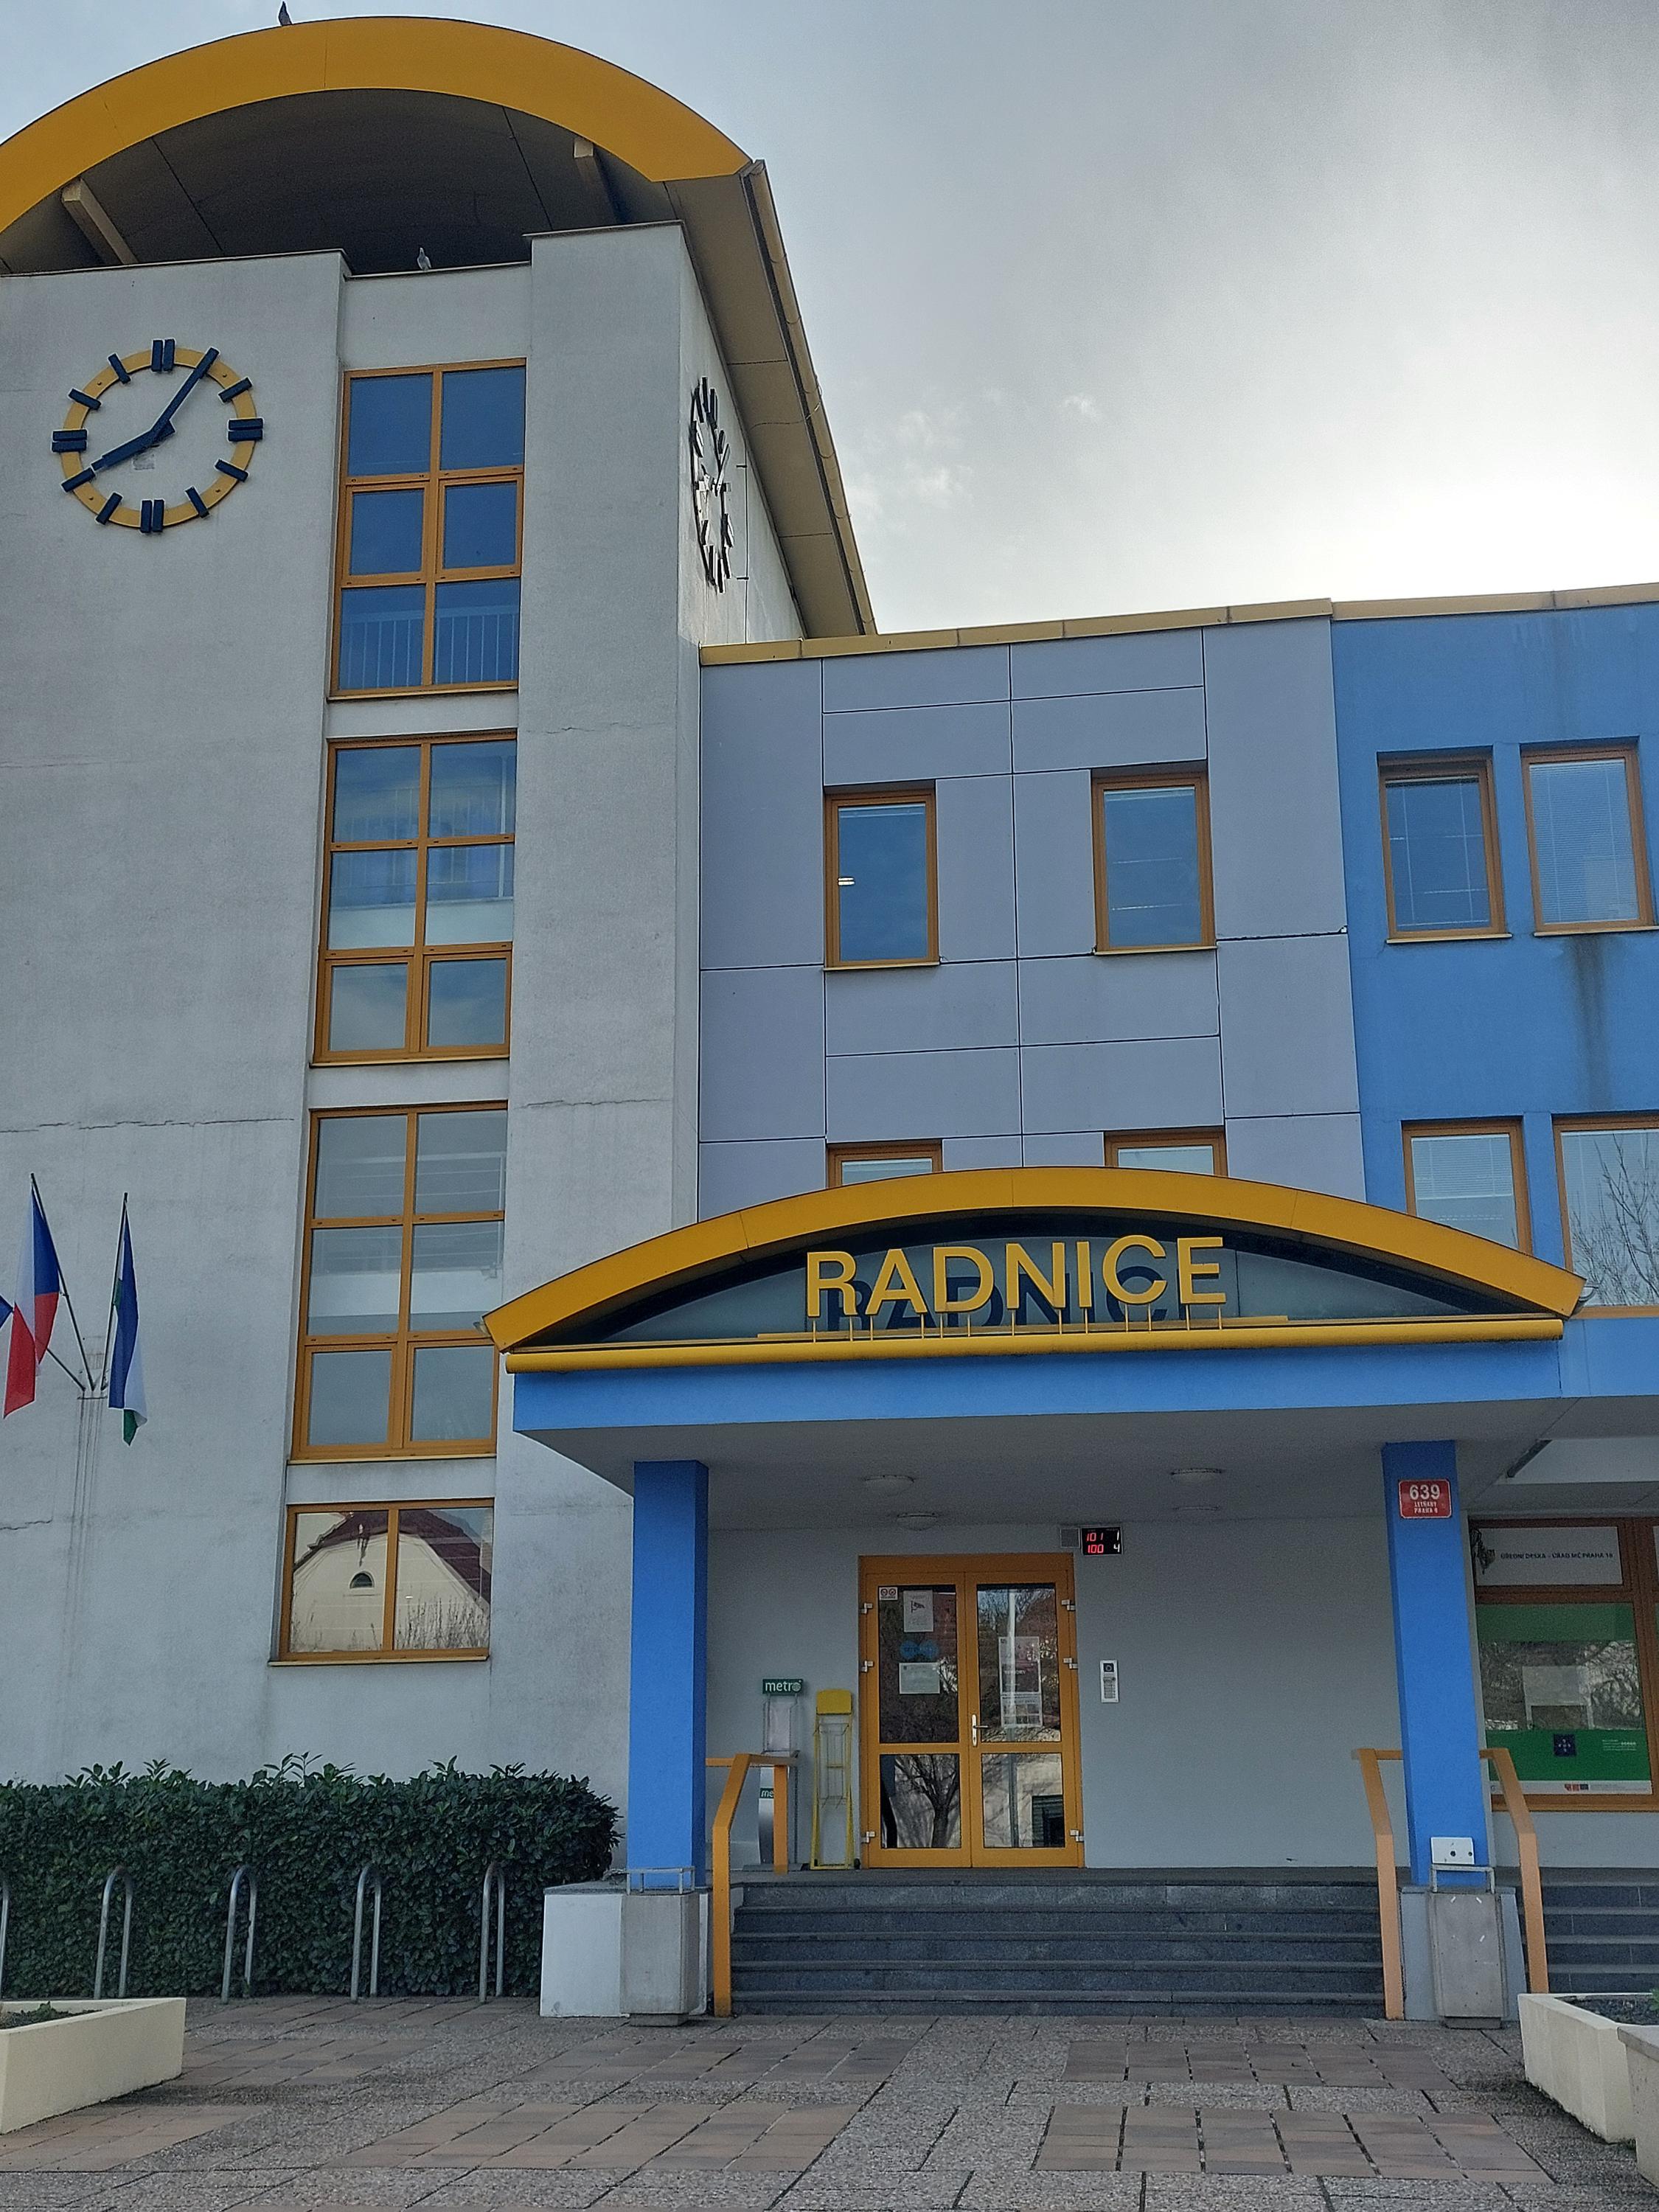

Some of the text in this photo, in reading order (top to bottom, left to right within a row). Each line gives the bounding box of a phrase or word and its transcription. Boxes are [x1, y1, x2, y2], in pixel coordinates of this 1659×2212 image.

[807, 1234, 1227, 1318] RADNICE
[1409, 1484, 1440, 1500] 639
[1086, 1532, 1104, 1542] 101
[1088, 1543, 1120, 1554] 100 4
[765, 1681, 801, 1692] metro
